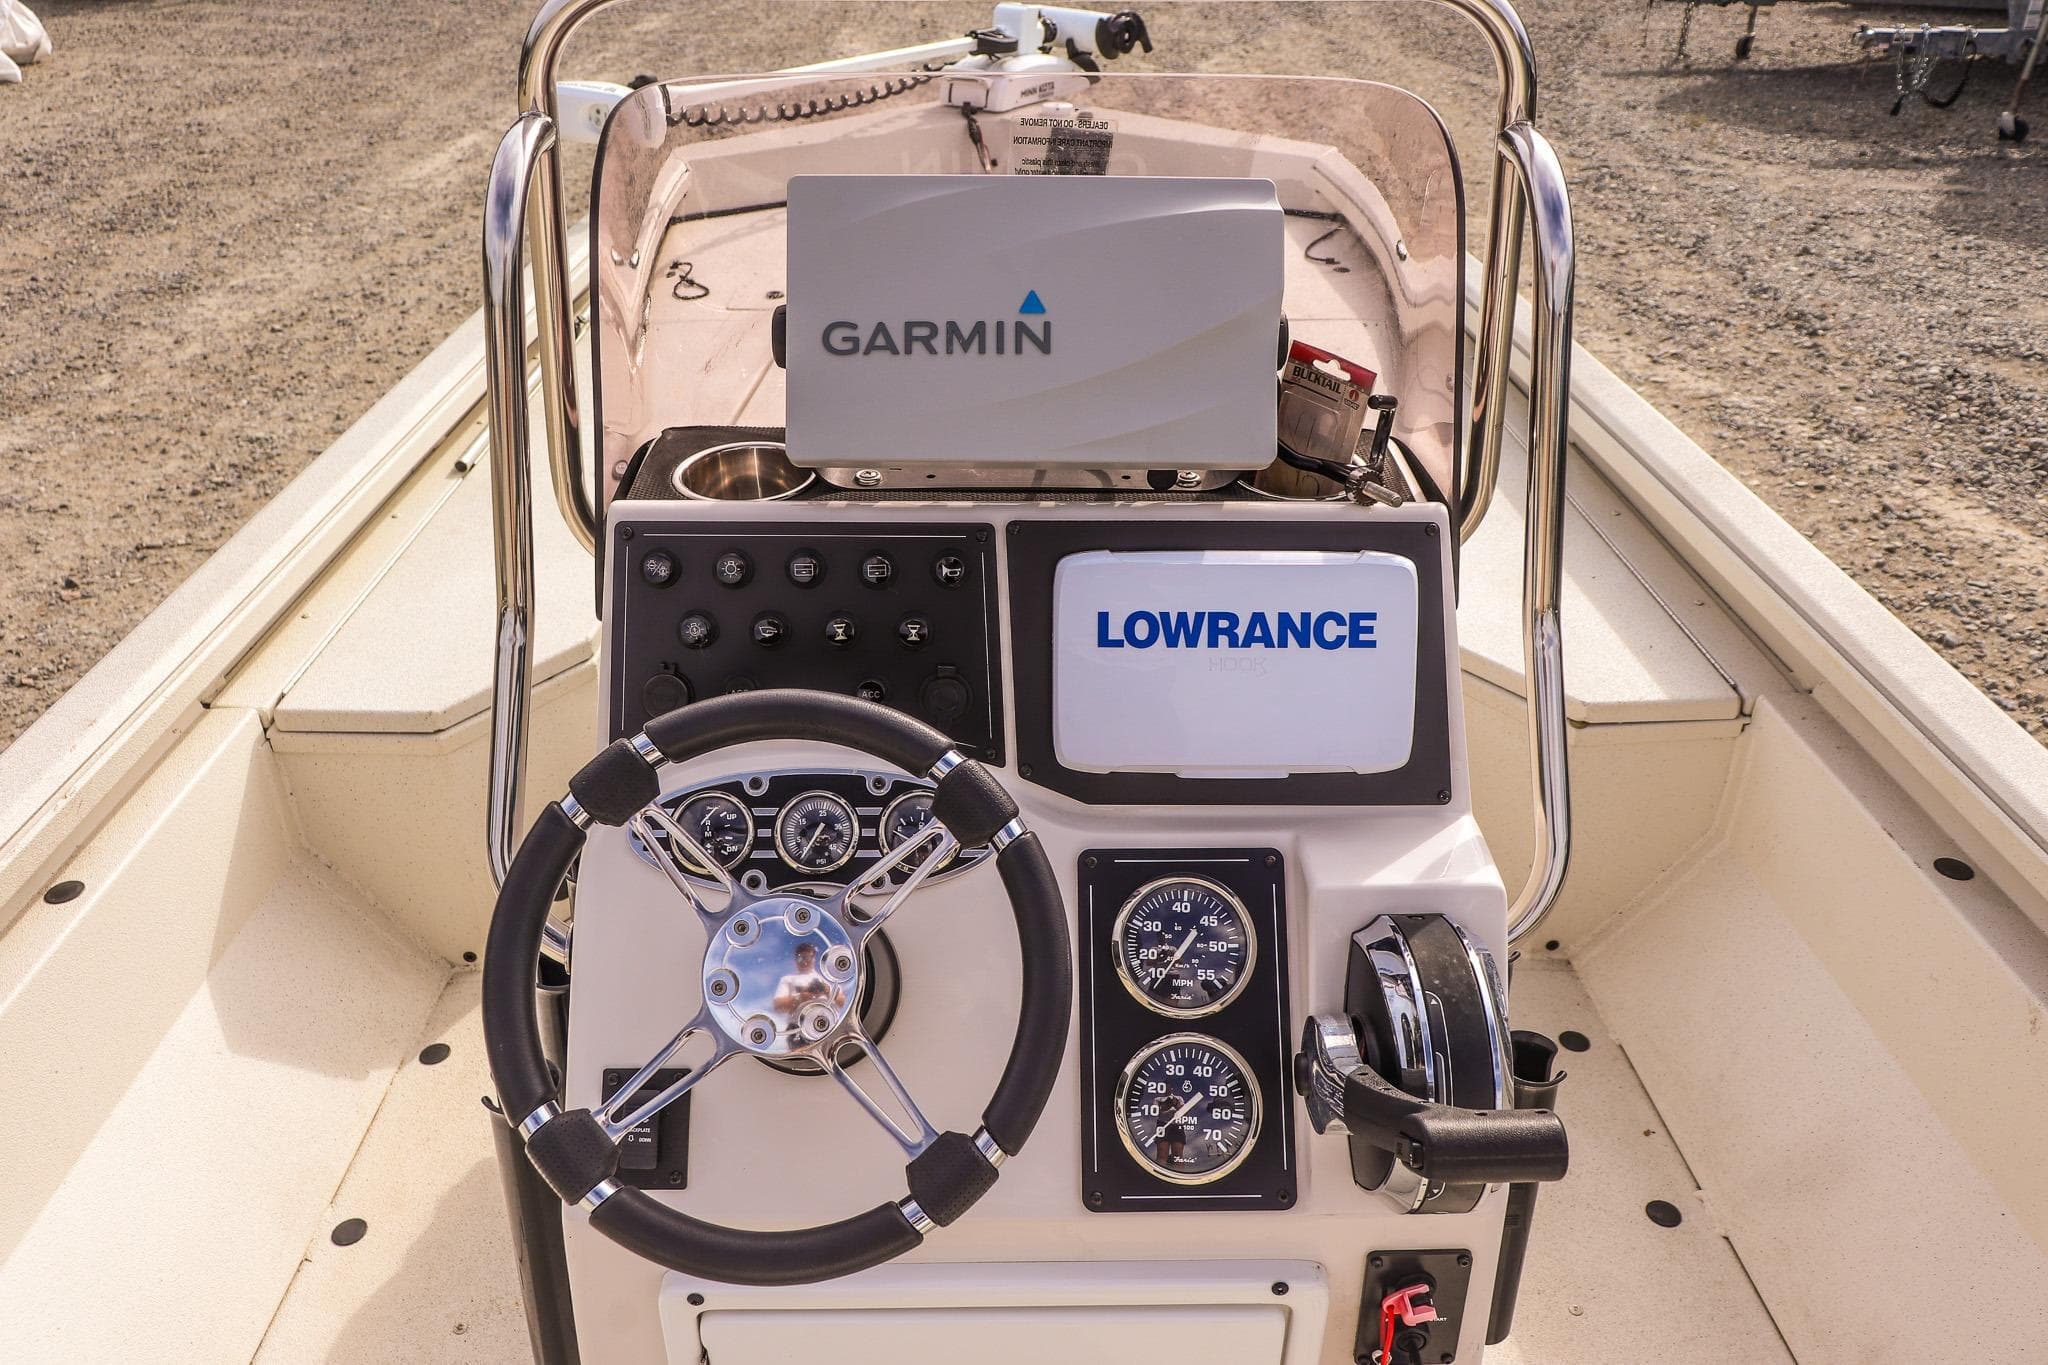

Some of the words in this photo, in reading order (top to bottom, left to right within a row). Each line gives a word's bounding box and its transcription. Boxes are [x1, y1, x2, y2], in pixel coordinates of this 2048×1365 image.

[822, 320, 1051, 356] GARMIN
[1293, 366, 1341, 394] BUCKTAIL
[1097, 610, 1377, 650] LOWRANCE
[862, 690, 880, 699] ACC
[726, 845, 738, 853] DN
[1172, 902, 1191, 913] 40
[1143, 921, 1162, 931] 30
[1199, 915, 1218, 926] 45
[1208, 941, 1228, 952] 50
[1139, 949, 1158, 960] 20
[1148, 968, 1166, 979] 10
[1197, 969, 1216, 981] 55
[1172, 979, 1194, 987] MPH
[1166, 1064, 1185, 1076] 30
[1193, 1065, 1213, 1077] 40
[1147, 1082, 1167, 1093] 20
[1209, 1085, 1228, 1097] 50
[1141, 1104, 1160, 1116] 10
[1212, 1108, 1231, 1120] 60
[1175, 1116, 1198, 1125] RPM
[1156, 1126, 1165, 1138] 0
[1203, 1129, 1222, 1140] 70
